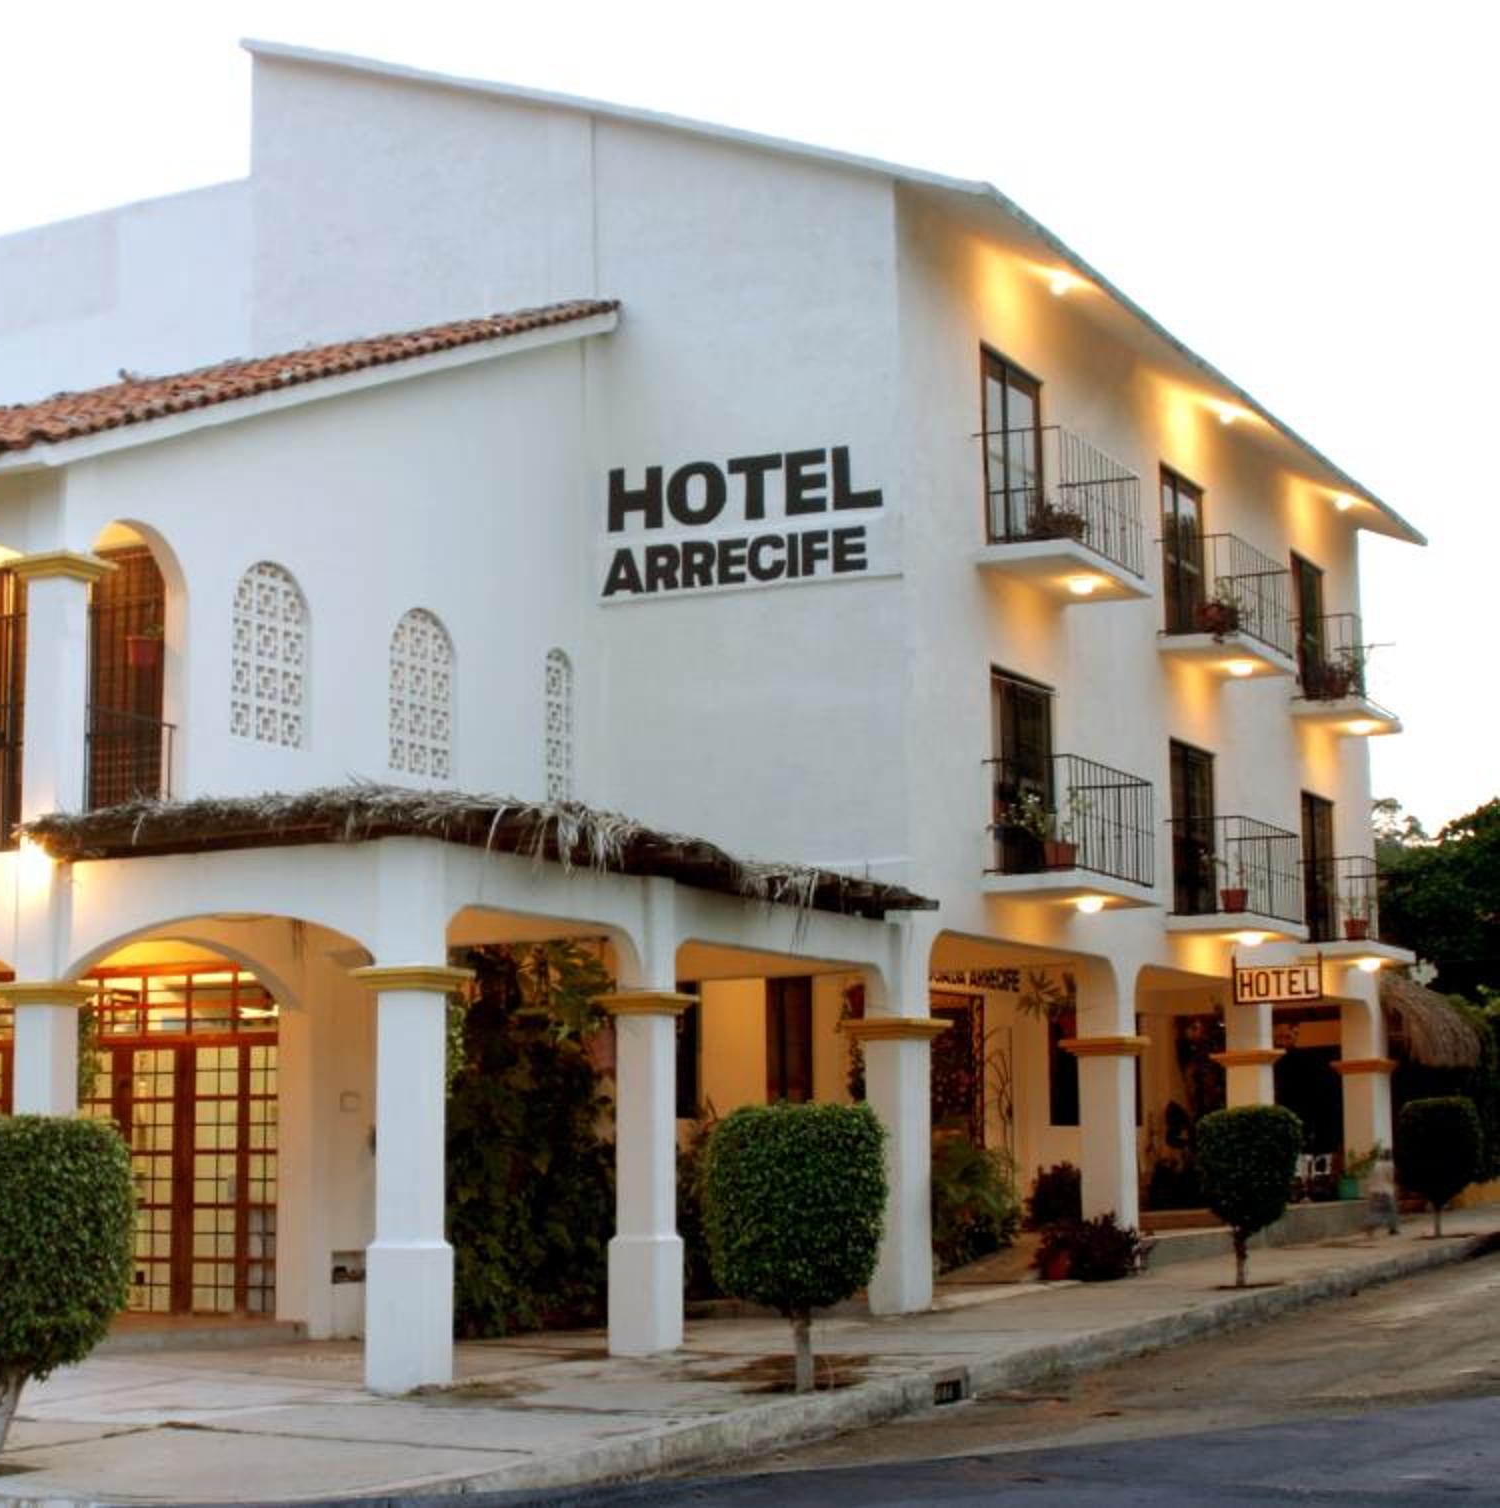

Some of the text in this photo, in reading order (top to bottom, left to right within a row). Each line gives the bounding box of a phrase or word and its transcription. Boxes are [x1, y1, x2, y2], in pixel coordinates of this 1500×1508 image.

[607, 446, 883, 532] HOTEL
[602, 526, 868, 597] ARRECIFE
[1238, 968, 1318, 998] HOTEL
